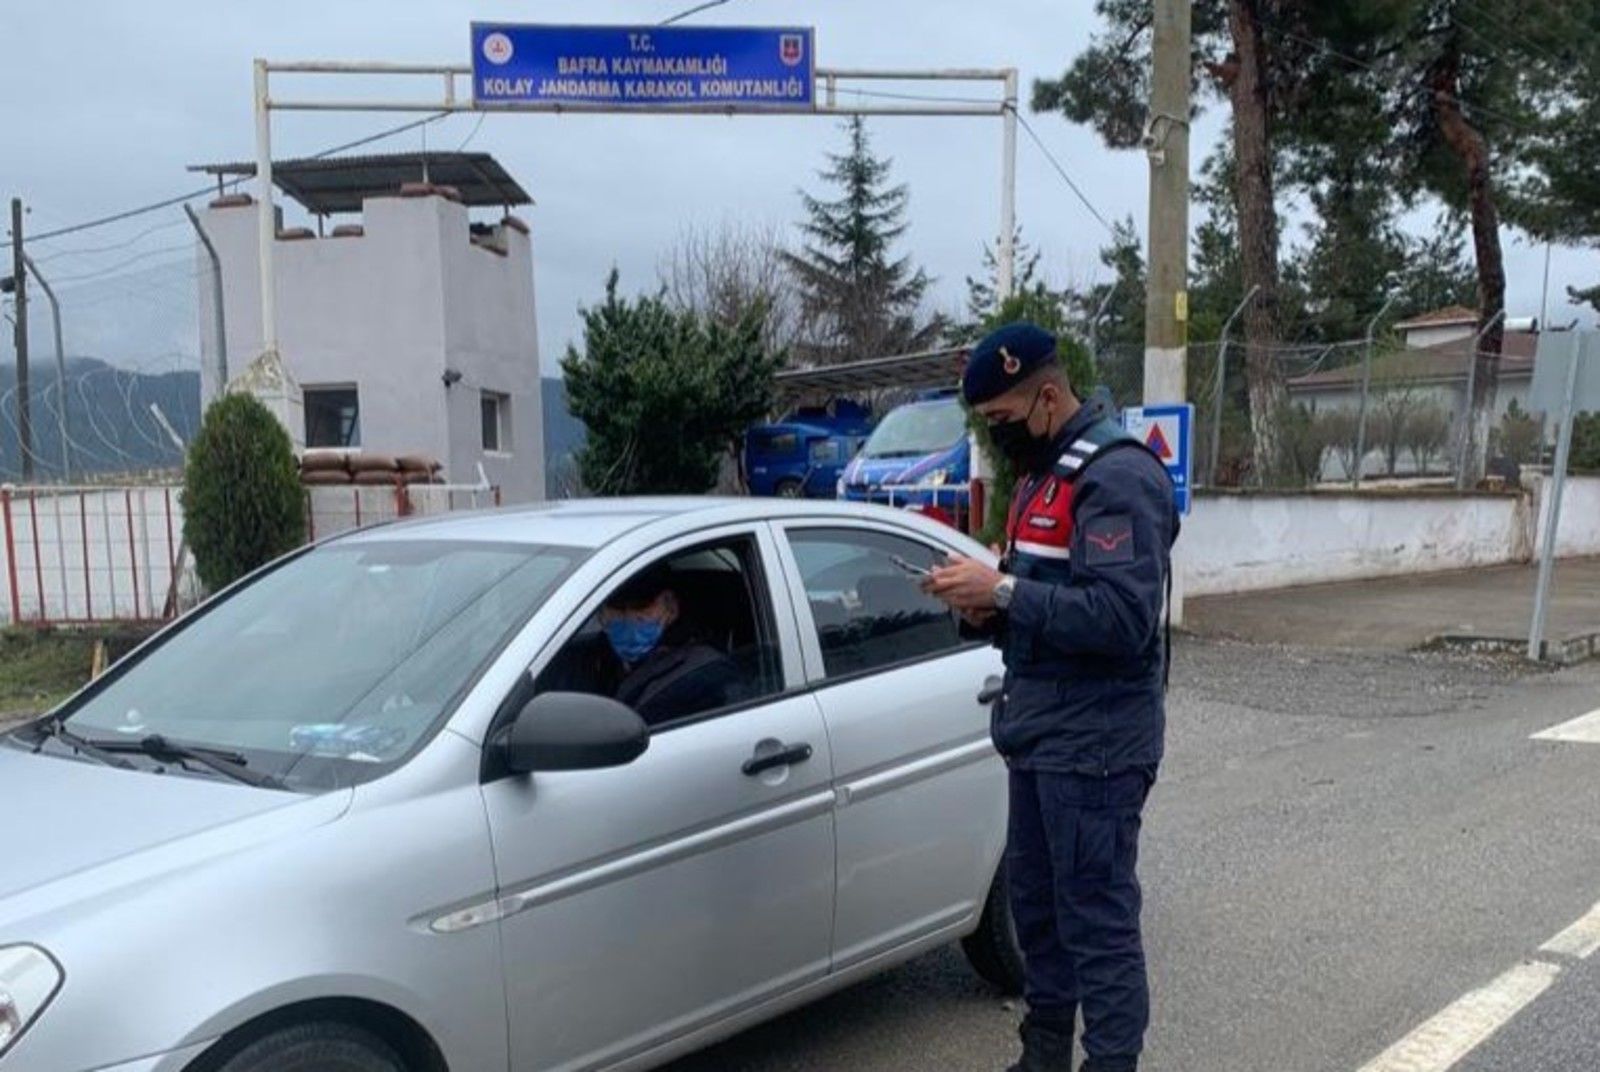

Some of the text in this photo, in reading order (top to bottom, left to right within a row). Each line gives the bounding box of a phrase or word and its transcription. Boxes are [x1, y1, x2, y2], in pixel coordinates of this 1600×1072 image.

[628, 33, 656, 51] T.C.
[558, 54, 727, 75] BAFRA KAYMAKAMLIĞI
[483, 76, 803, 97] KOLAY JANDARMA KARAKOL KOMUTANLIĞI
